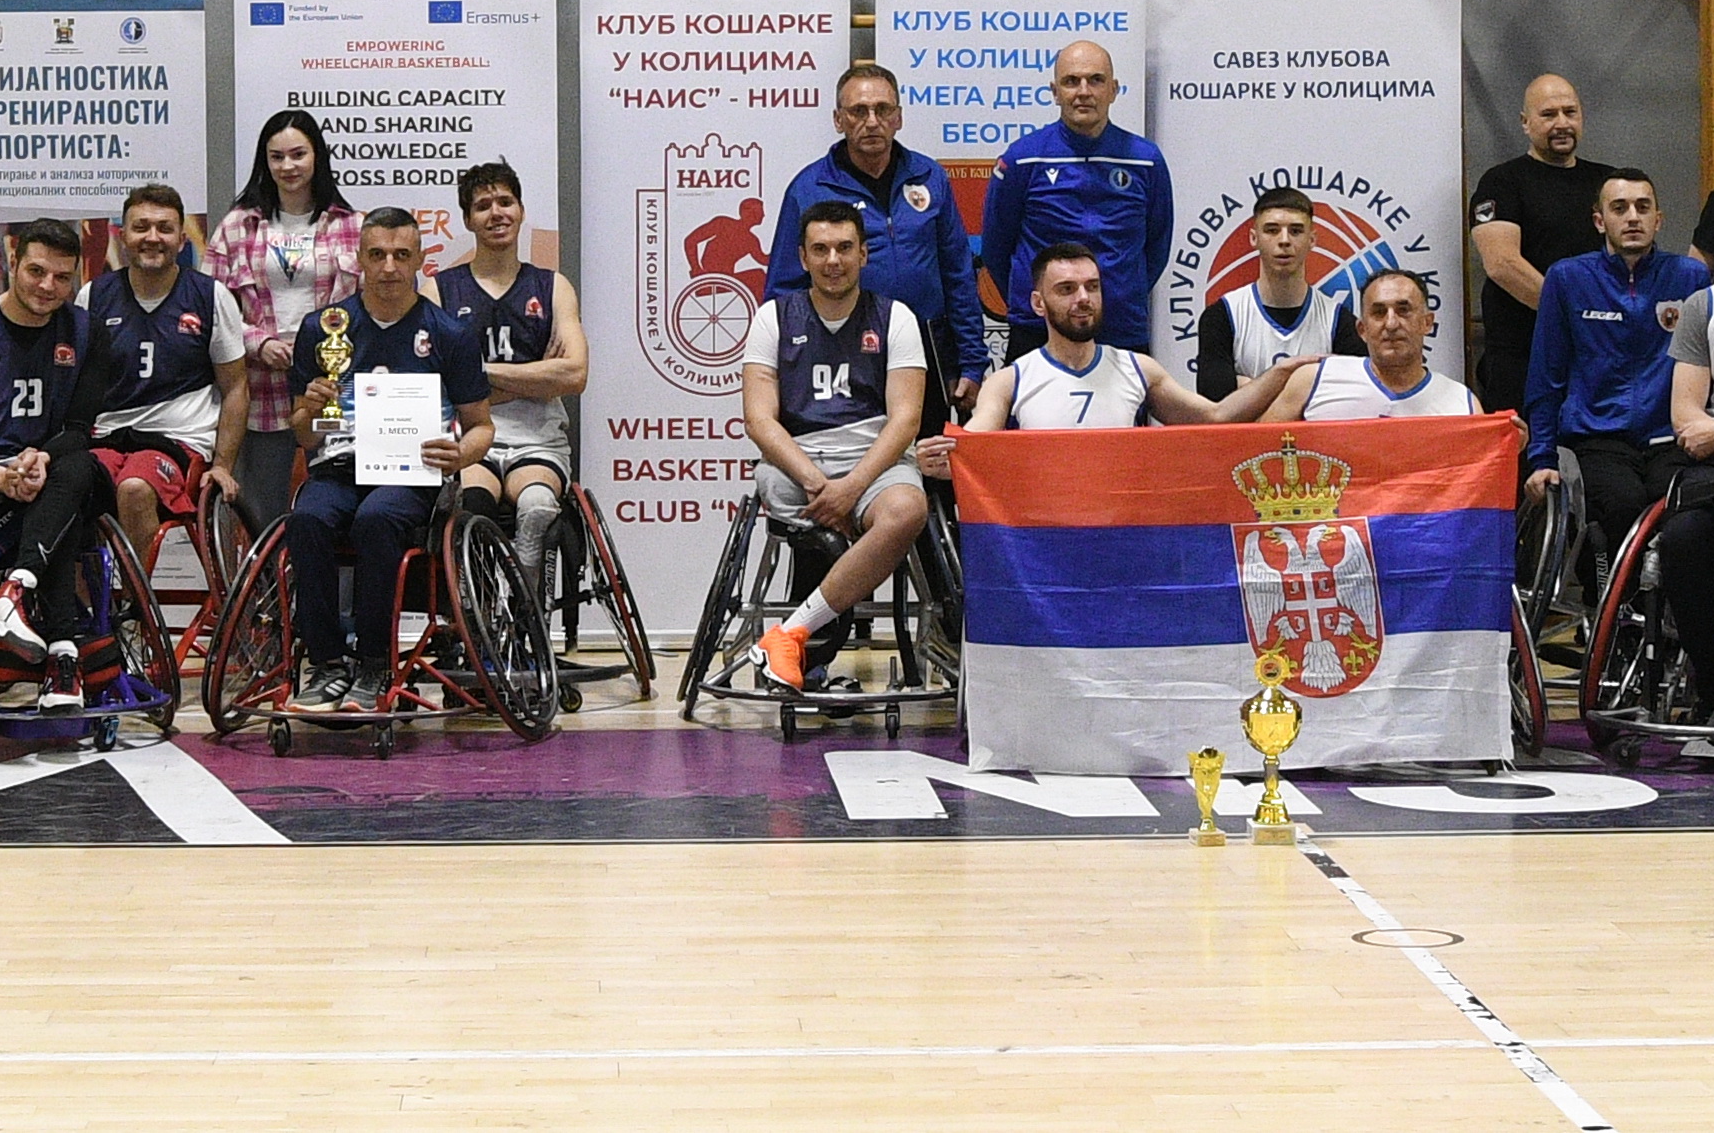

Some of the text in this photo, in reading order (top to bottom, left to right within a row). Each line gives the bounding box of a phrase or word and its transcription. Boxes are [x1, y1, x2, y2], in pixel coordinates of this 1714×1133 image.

[289, 4, 328, 13] Funded by
[303, 14, 339, 22] European
[597, 14, 833, 35] КЛУБ КОШАРКЕ
[893, 11, 1129, 32] КЛУБ КОШАРКЕ
[346, 40, 445, 52] EMPOWERING
[301, 57, 490, 70] WHEELCHAIR BASKETBALL:
[613, 51, 817, 75] У КОЛИЦИМА
[909, 49, 1059, 72] У КОЛИЦИ
[1213, 49, 1390, 69] САВЕЗ КЛУБОВА
[287, 90, 506, 107] BUILDING CAPACITY
[748, 88, 820, 108] НИШ
[1169, 80, 1435, 101] КОШАРКЕ У КОЛИЦИМА
[321, 116, 473, 133] AND SHARING
[328, 143, 467, 159] KNOWLEDGE
[40, 171, 47, 179] и
[50, 171, 94, 179] анализа
[97, 170, 159, 181] моторичких
[162, 170, 169, 179] и
[330, 169, 385, 185] ROSS
[676, 169, 750, 188] НАИС
[646, 199, 657, 245] КЛУБ
[1170, 193, 1244, 341] КЛУБОВА
[1249, 166, 1411, 232] КОШАРКЕ
[647, 251, 659, 339] КОШАРКЕ
[1582, 310, 1623, 322] LEGEA
[486, 325, 514, 362] 14
[138, 341, 154, 378] 3
[812, 363, 852, 400] 94
[11, 378, 43, 418] 23
[1069, 391, 1094, 424] 7
[607, 417, 749, 440] WHEELC
[616, 500, 701, 524] CLUB
